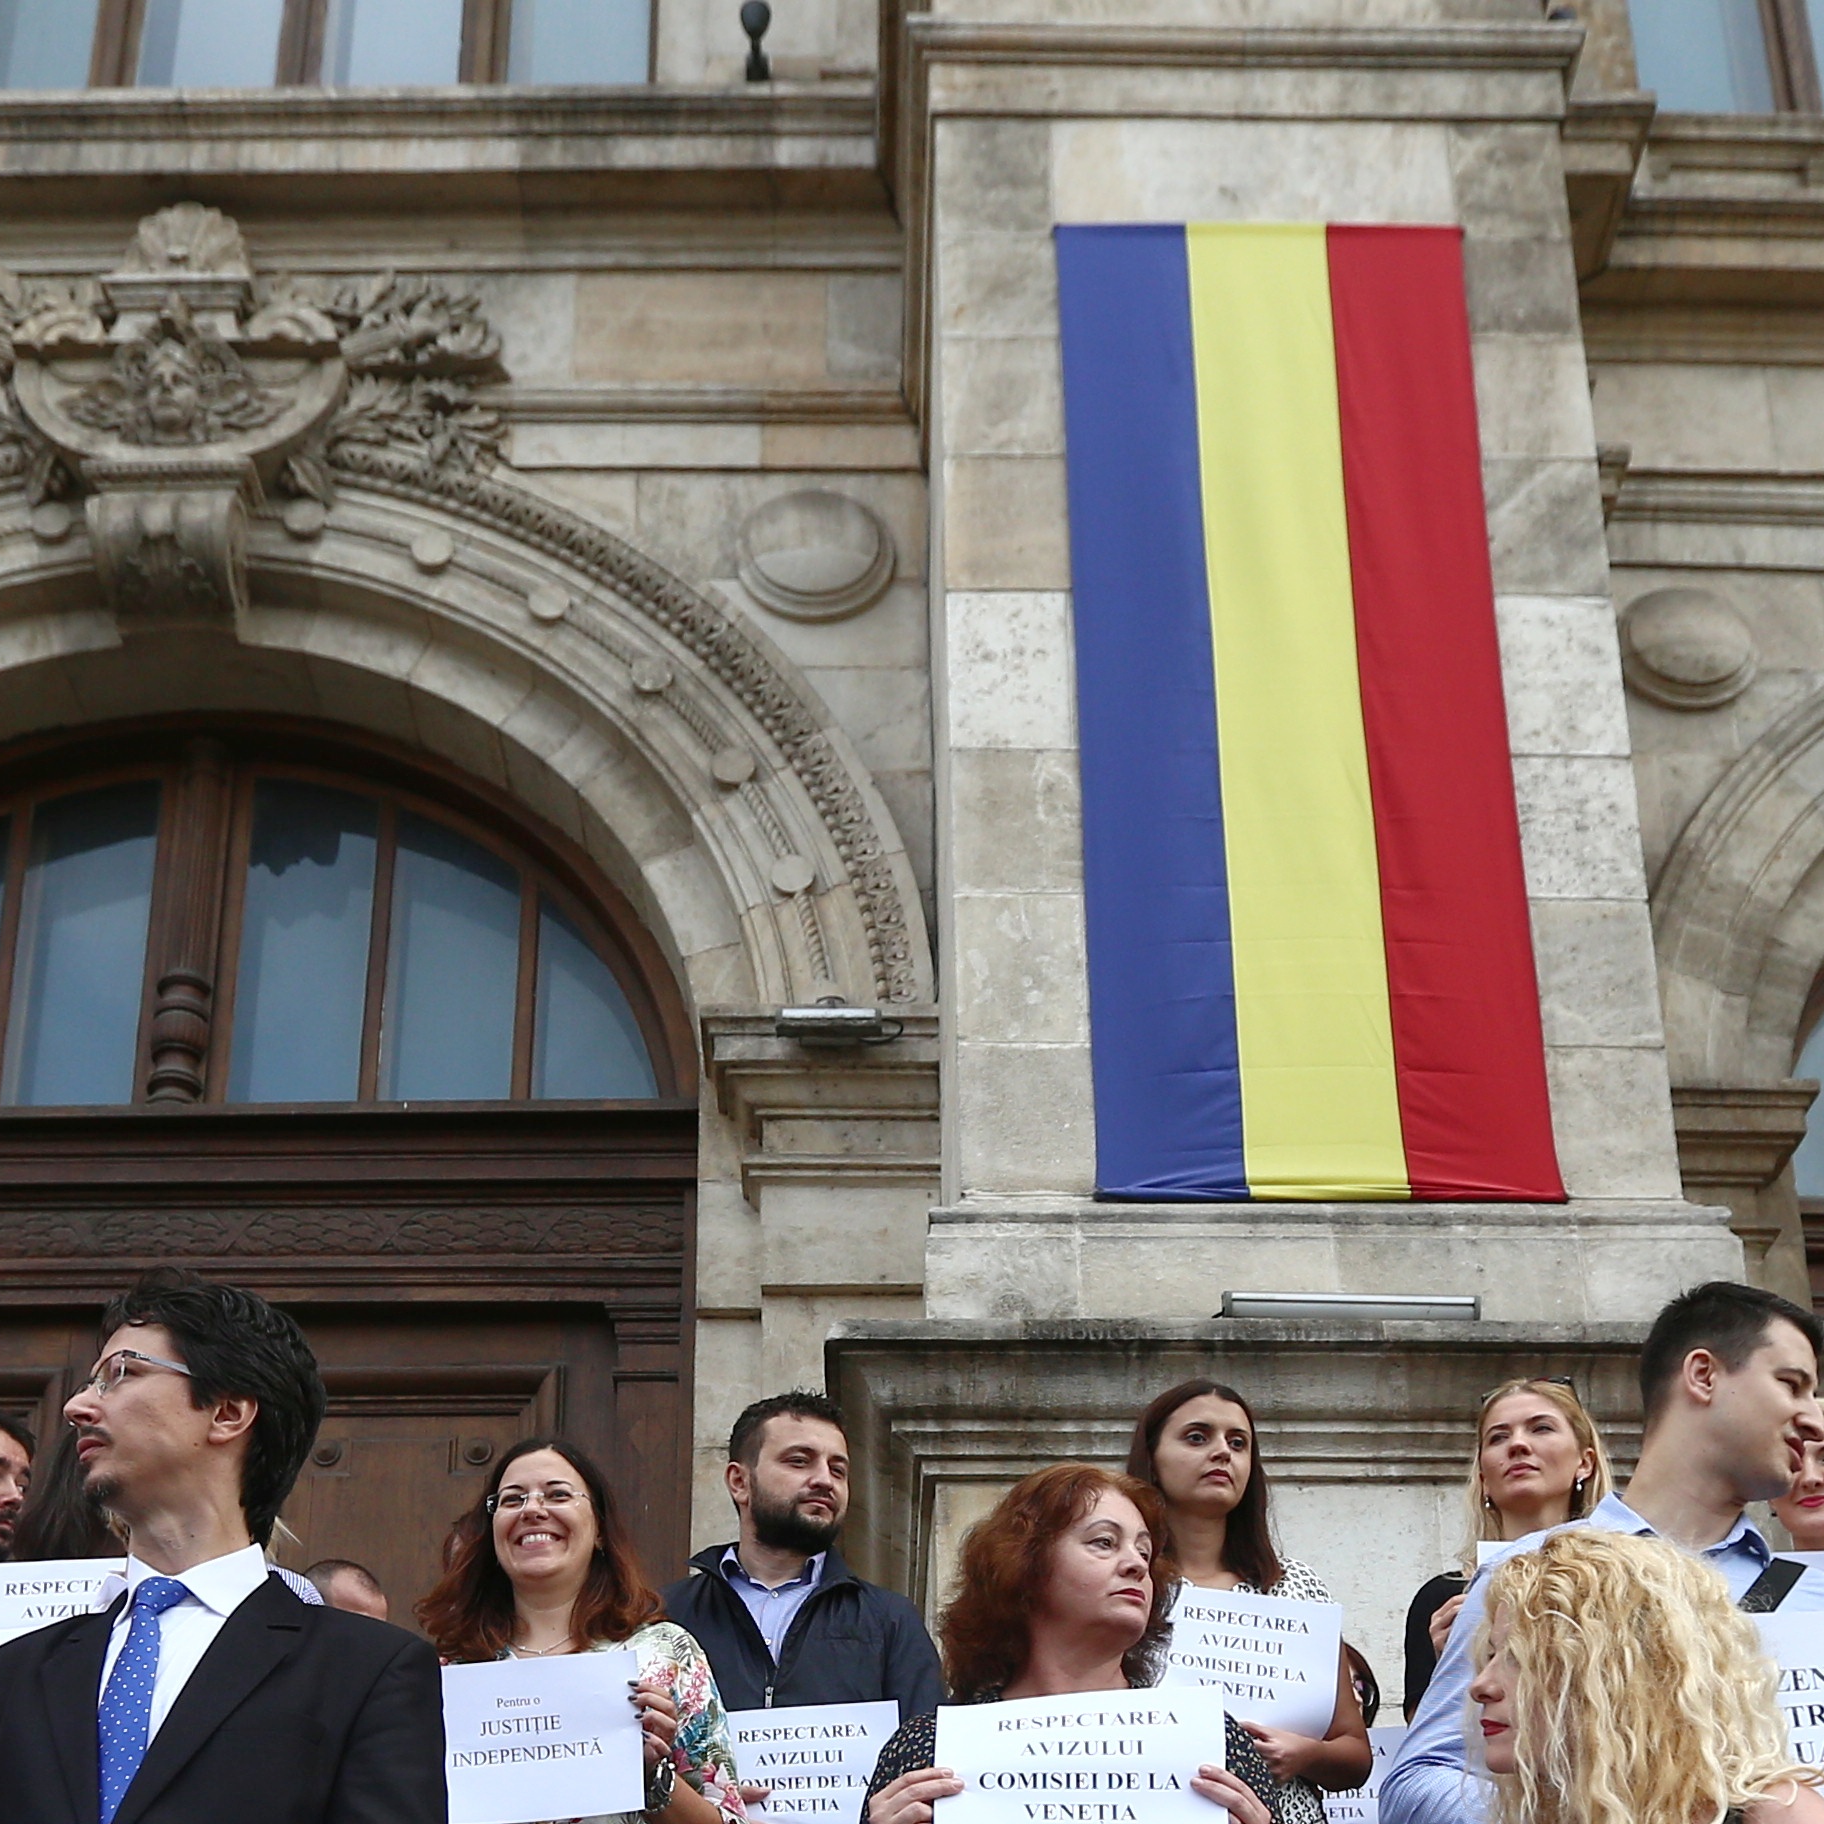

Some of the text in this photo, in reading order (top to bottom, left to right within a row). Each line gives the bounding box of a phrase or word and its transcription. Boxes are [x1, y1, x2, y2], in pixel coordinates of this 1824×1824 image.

[5, 1579, 101, 1596] RESPECTA
[1183, 1605, 1310, 1635] RESPECTAREA
[1198, 1633, 1285, 1655] AVIZULUI
[1169, 1652, 1307, 1683] COMISIEI DE LA
[496, 1697, 541, 1709] Pentru o
[480, 1714, 562, 1737] JUSTIȚIE
[997, 1711, 1179, 1732] RESPECTAREA
[738, 1724, 868, 1743] RESPECTAREA
[452, 1737, 604, 1768] INDEPENDENTĂ
[1020, 1739, 1145, 1756] AVIZULUI
[755, 1750, 844, 1767] AVIZULUI
[740, 1774, 870, 1791] OMISIEI DE LA
[978, 1772, 1181, 1790] COMISIEI DE LA
[760, 1798, 840, 1815] VENEȚIA
[1023, 1803, 1137, 1824] VENEȚIA
[1328, 1806, 1365, 1820] EȚIA
